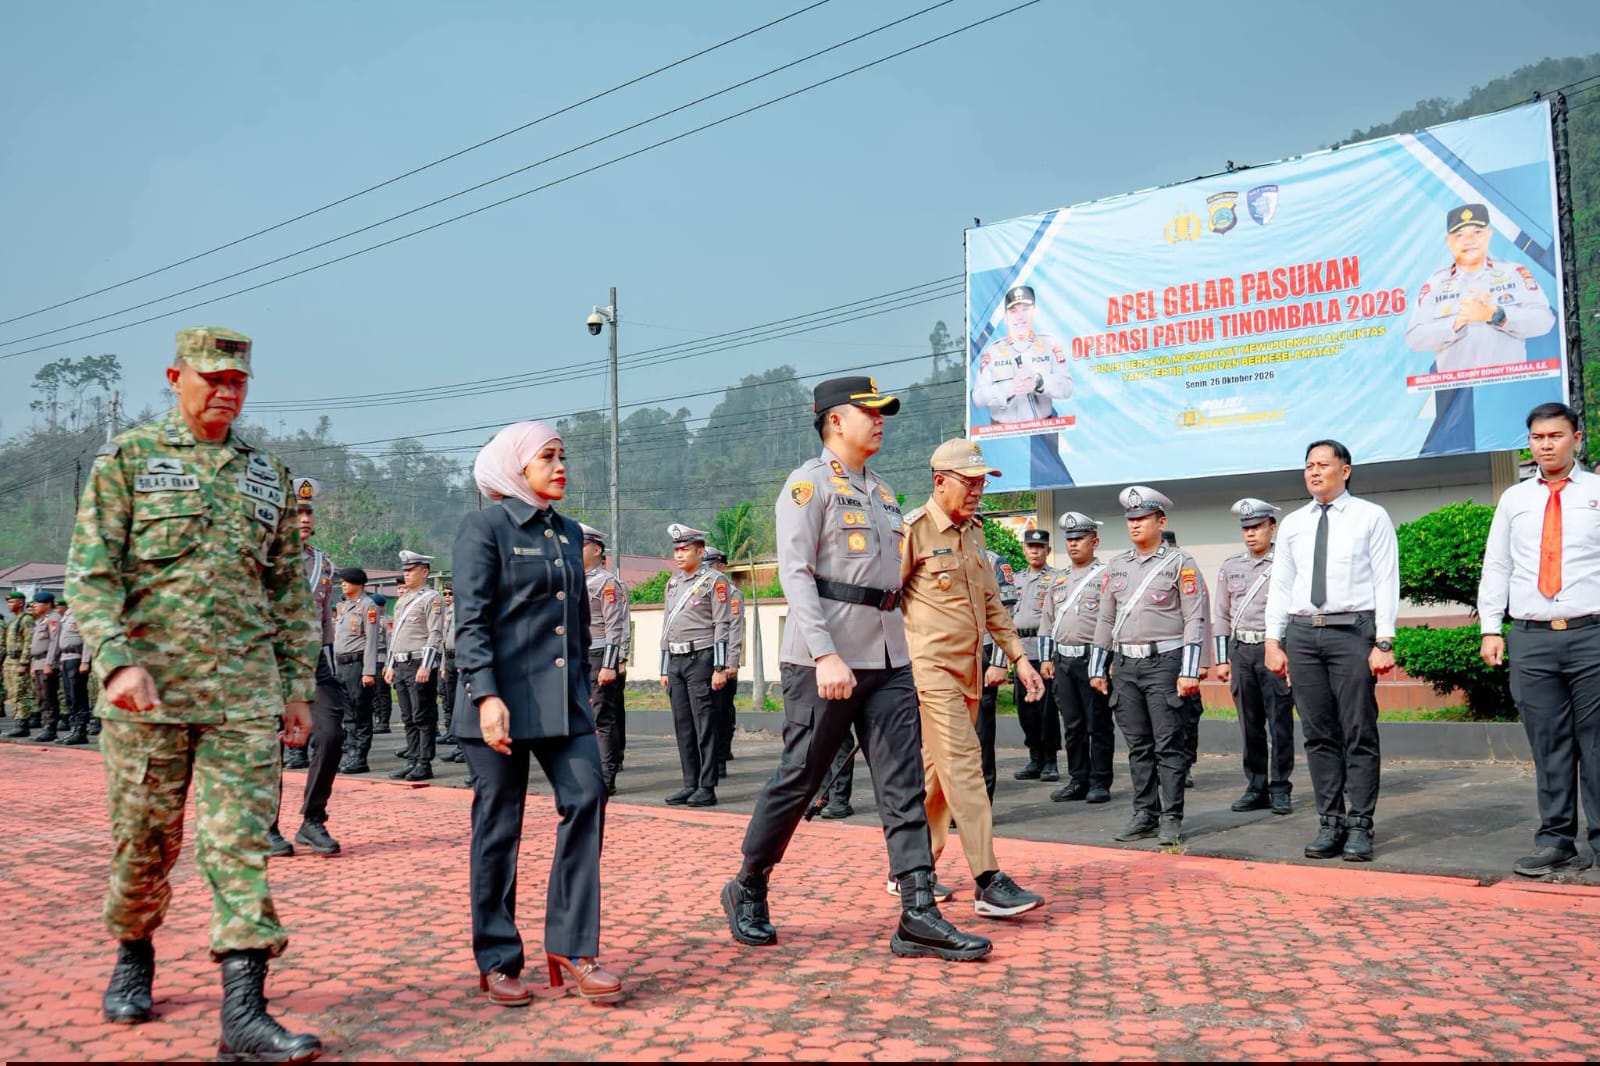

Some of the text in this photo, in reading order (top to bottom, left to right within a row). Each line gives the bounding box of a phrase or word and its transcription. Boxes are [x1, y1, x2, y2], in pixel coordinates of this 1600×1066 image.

[1106, 255, 1360, 327] APEL GELAR PASUKAN
[1489, 282, 1516, 293] POLRI
[1071, 288, 1407, 360] OPERASI PATUH TINOMBALA 2026
[1125, 356, 1170, 370] BERSAMA
[1172, 345, 1239, 364] MASYARAKAT
[1241, 335, 1316, 354] MEWUJUDKAN
[1318, 331, 1346, 344] LALU
[1348, 326, 1386, 340] LINTAS
[1187, 361, 1216, 373] AMAN
[1218, 359, 1239, 369] DAN
[1242, 345, 1339, 367] BERKESELAMATAN
[1210, 377, 1220, 386] 26
[1221, 374, 1253, 385] Oktober
[1254, 370, 1275, 381] 2026
[245, 483, 281, 502] TNI AD
